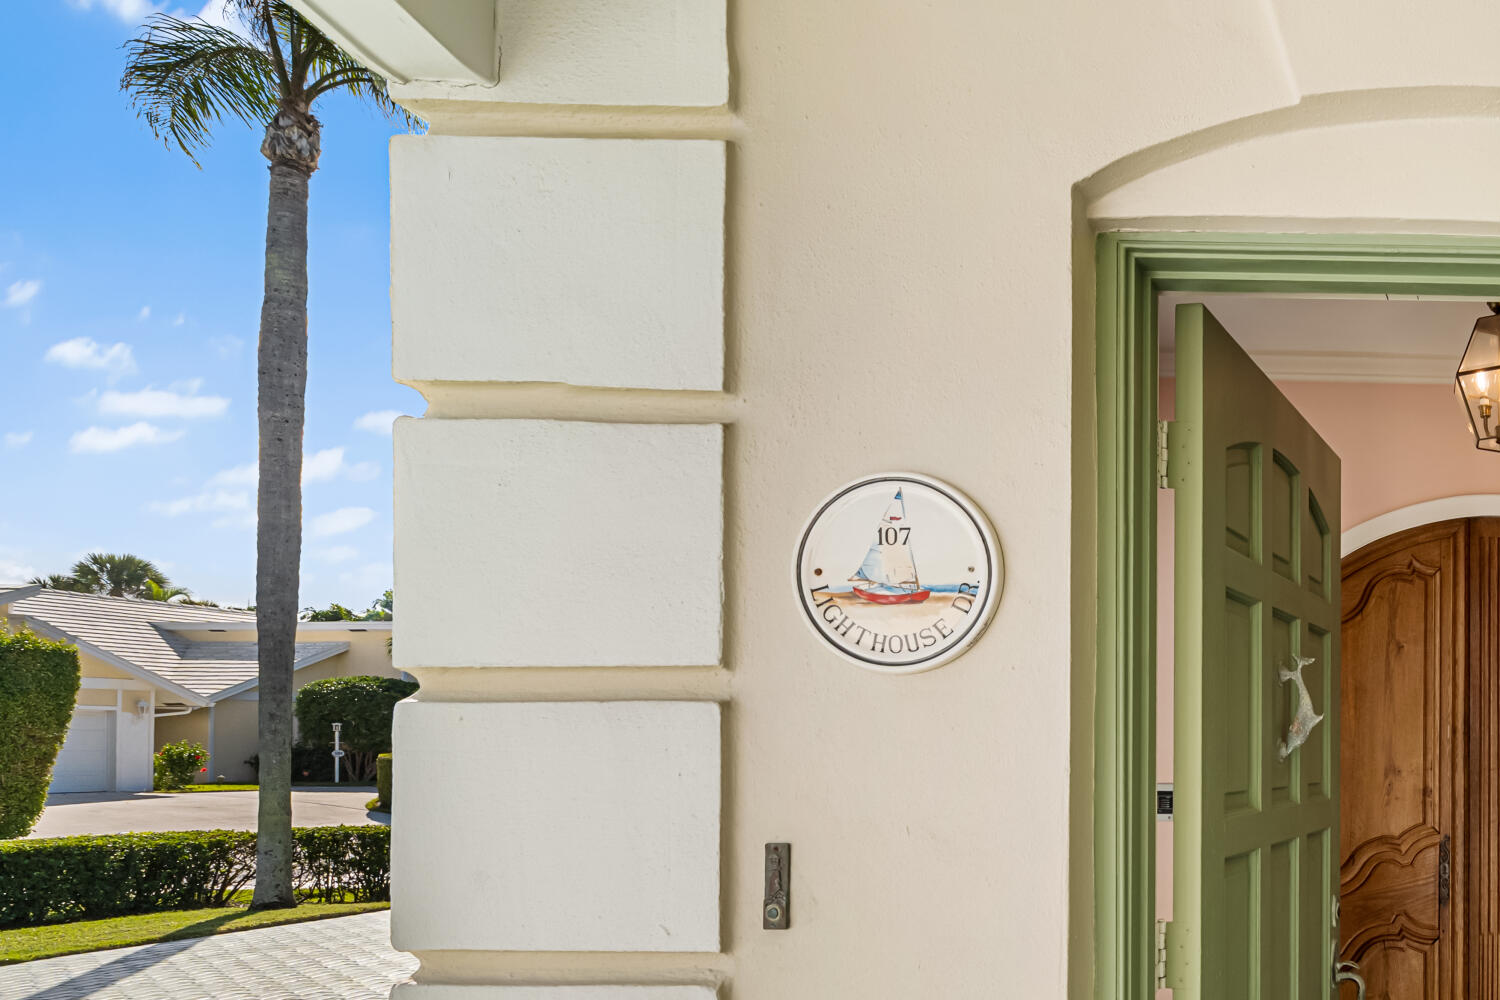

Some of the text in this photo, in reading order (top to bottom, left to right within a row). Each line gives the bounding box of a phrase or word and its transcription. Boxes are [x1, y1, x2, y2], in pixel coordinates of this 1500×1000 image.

[876, 527, 911, 546] 107
[810, 580, 980, 654] LIGHTHOUSE DR.
